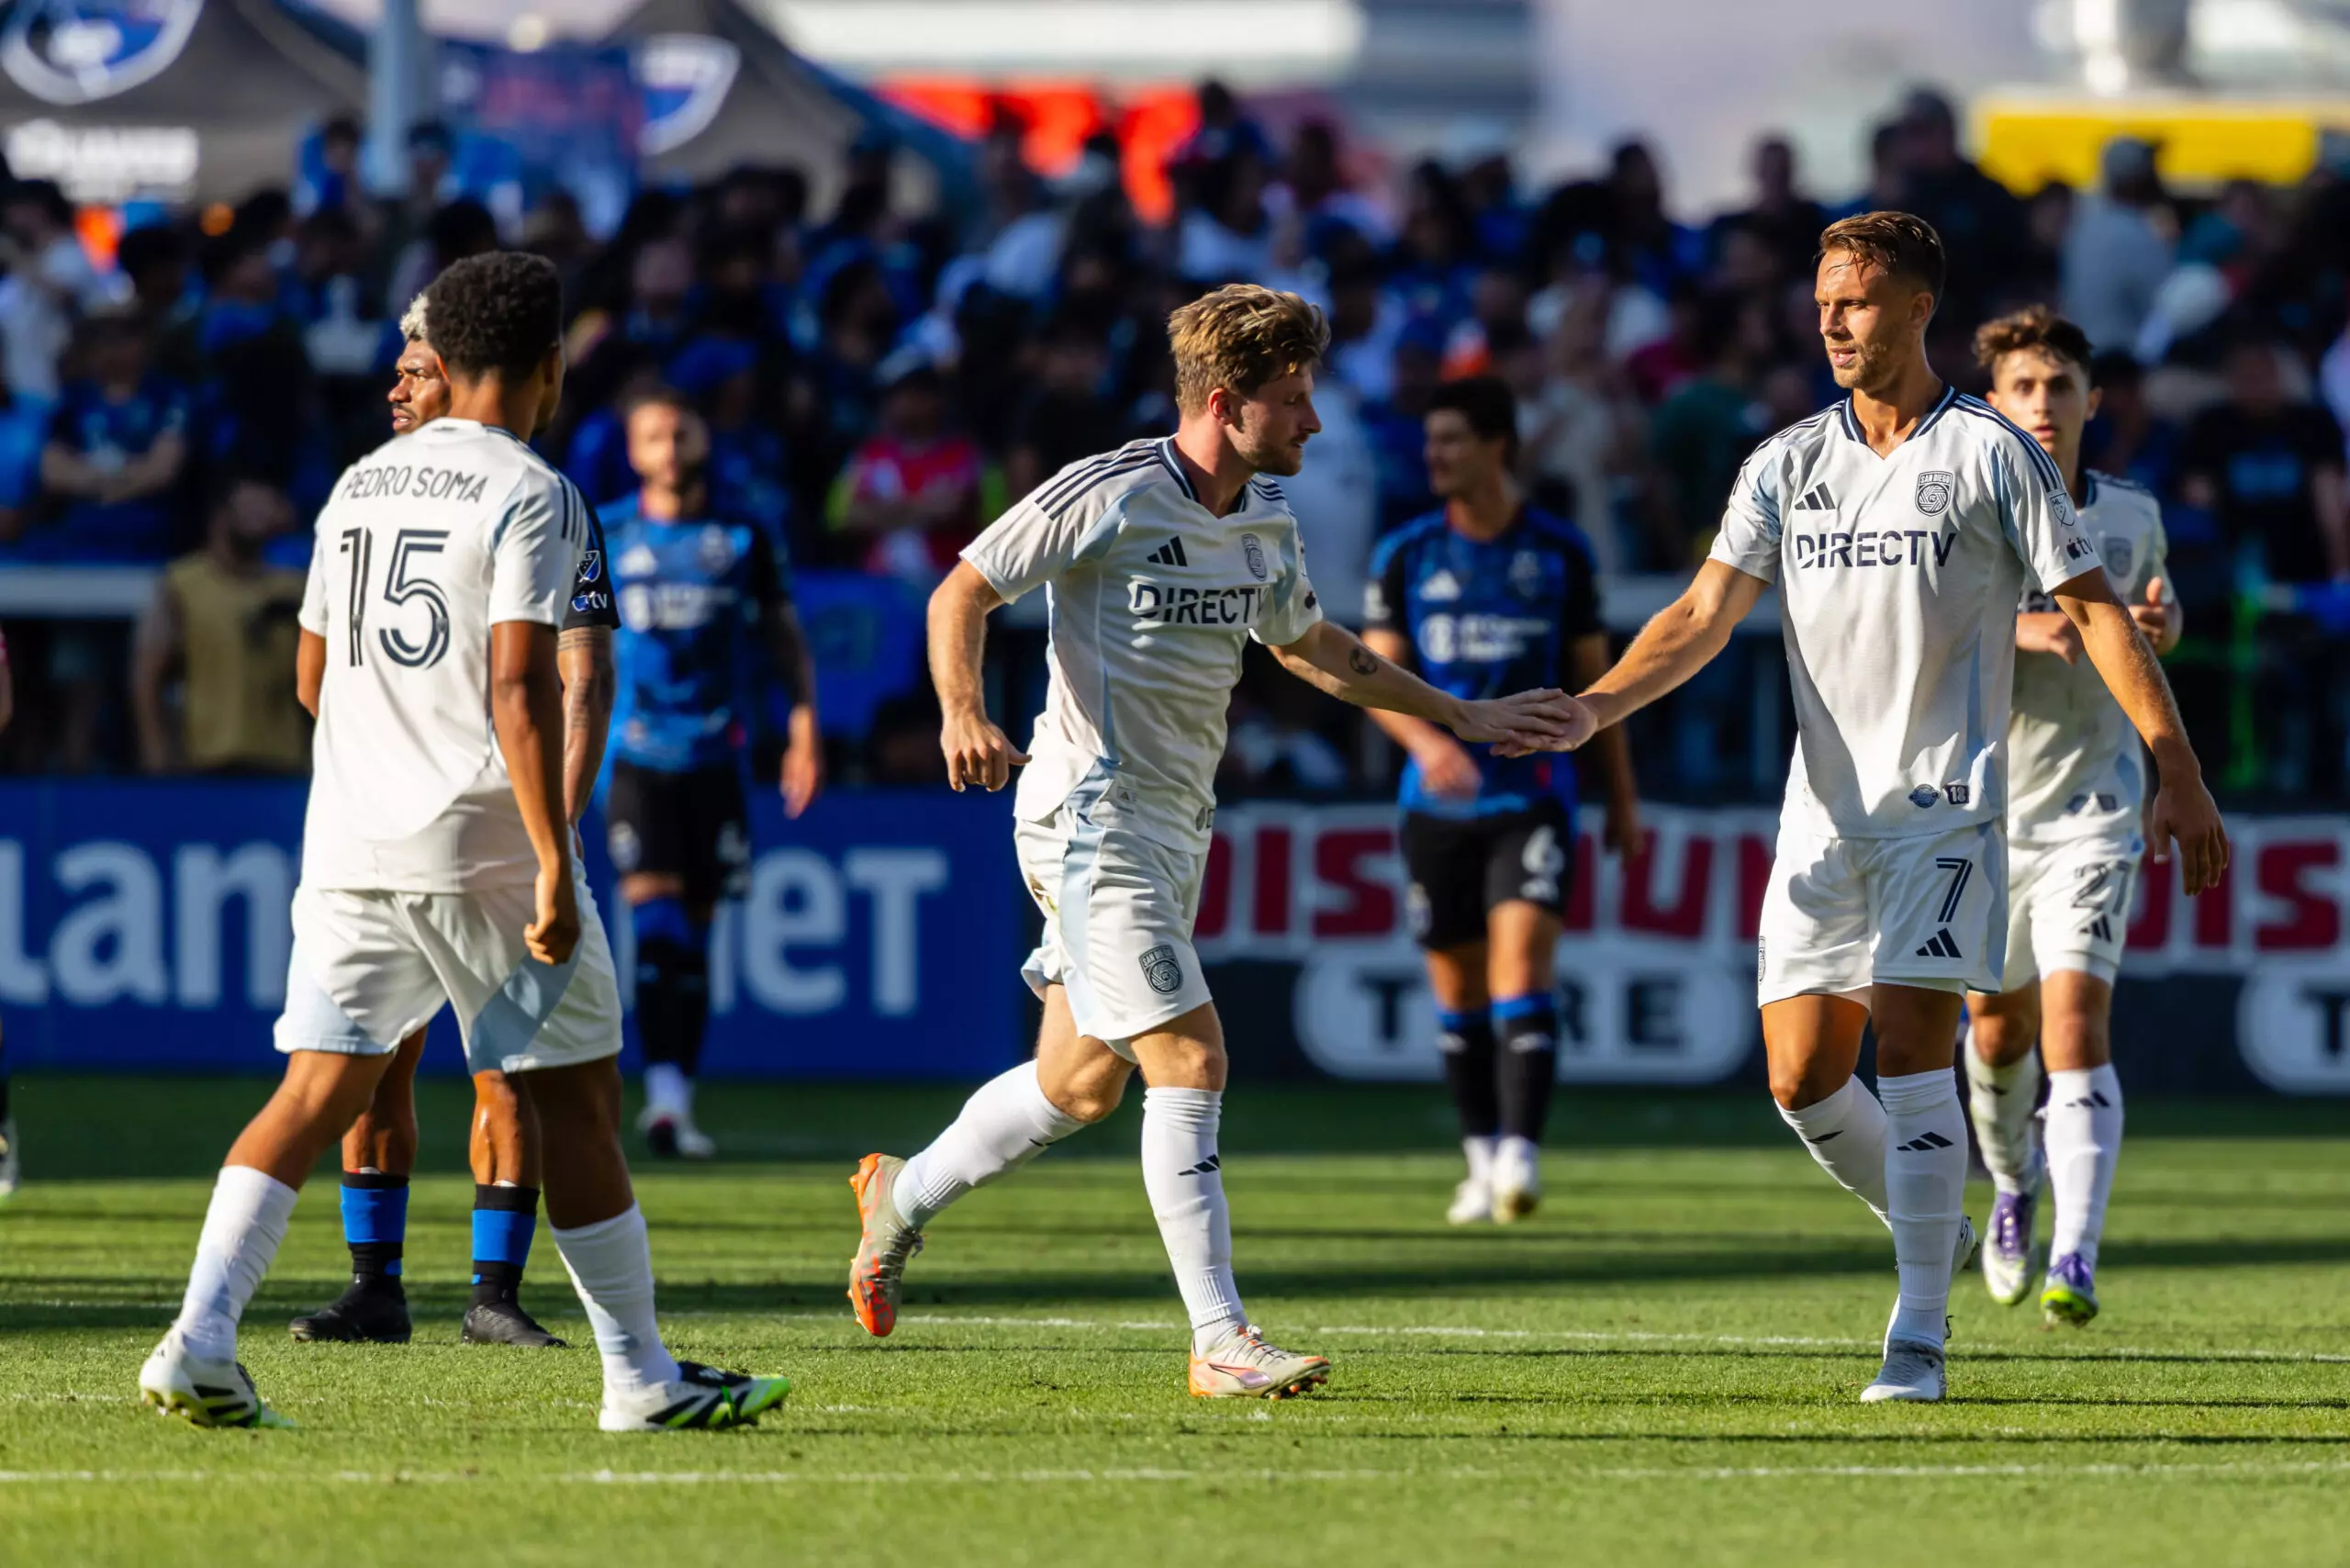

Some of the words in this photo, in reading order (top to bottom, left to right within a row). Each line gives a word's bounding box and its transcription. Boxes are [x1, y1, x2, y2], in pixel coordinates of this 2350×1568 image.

[341, 465, 412, 500] PEDRO
[411, 466, 488, 504] SOMA
[1919, 474, 1933, 485] SAN
[1933, 474, 1951, 485] DIEGO
[1796, 530, 1957, 569] DIRECTV
[340, 526, 452, 670] 15
[1950, 786, 1966, 802] 18
[1936, 857, 1973, 923] 7
